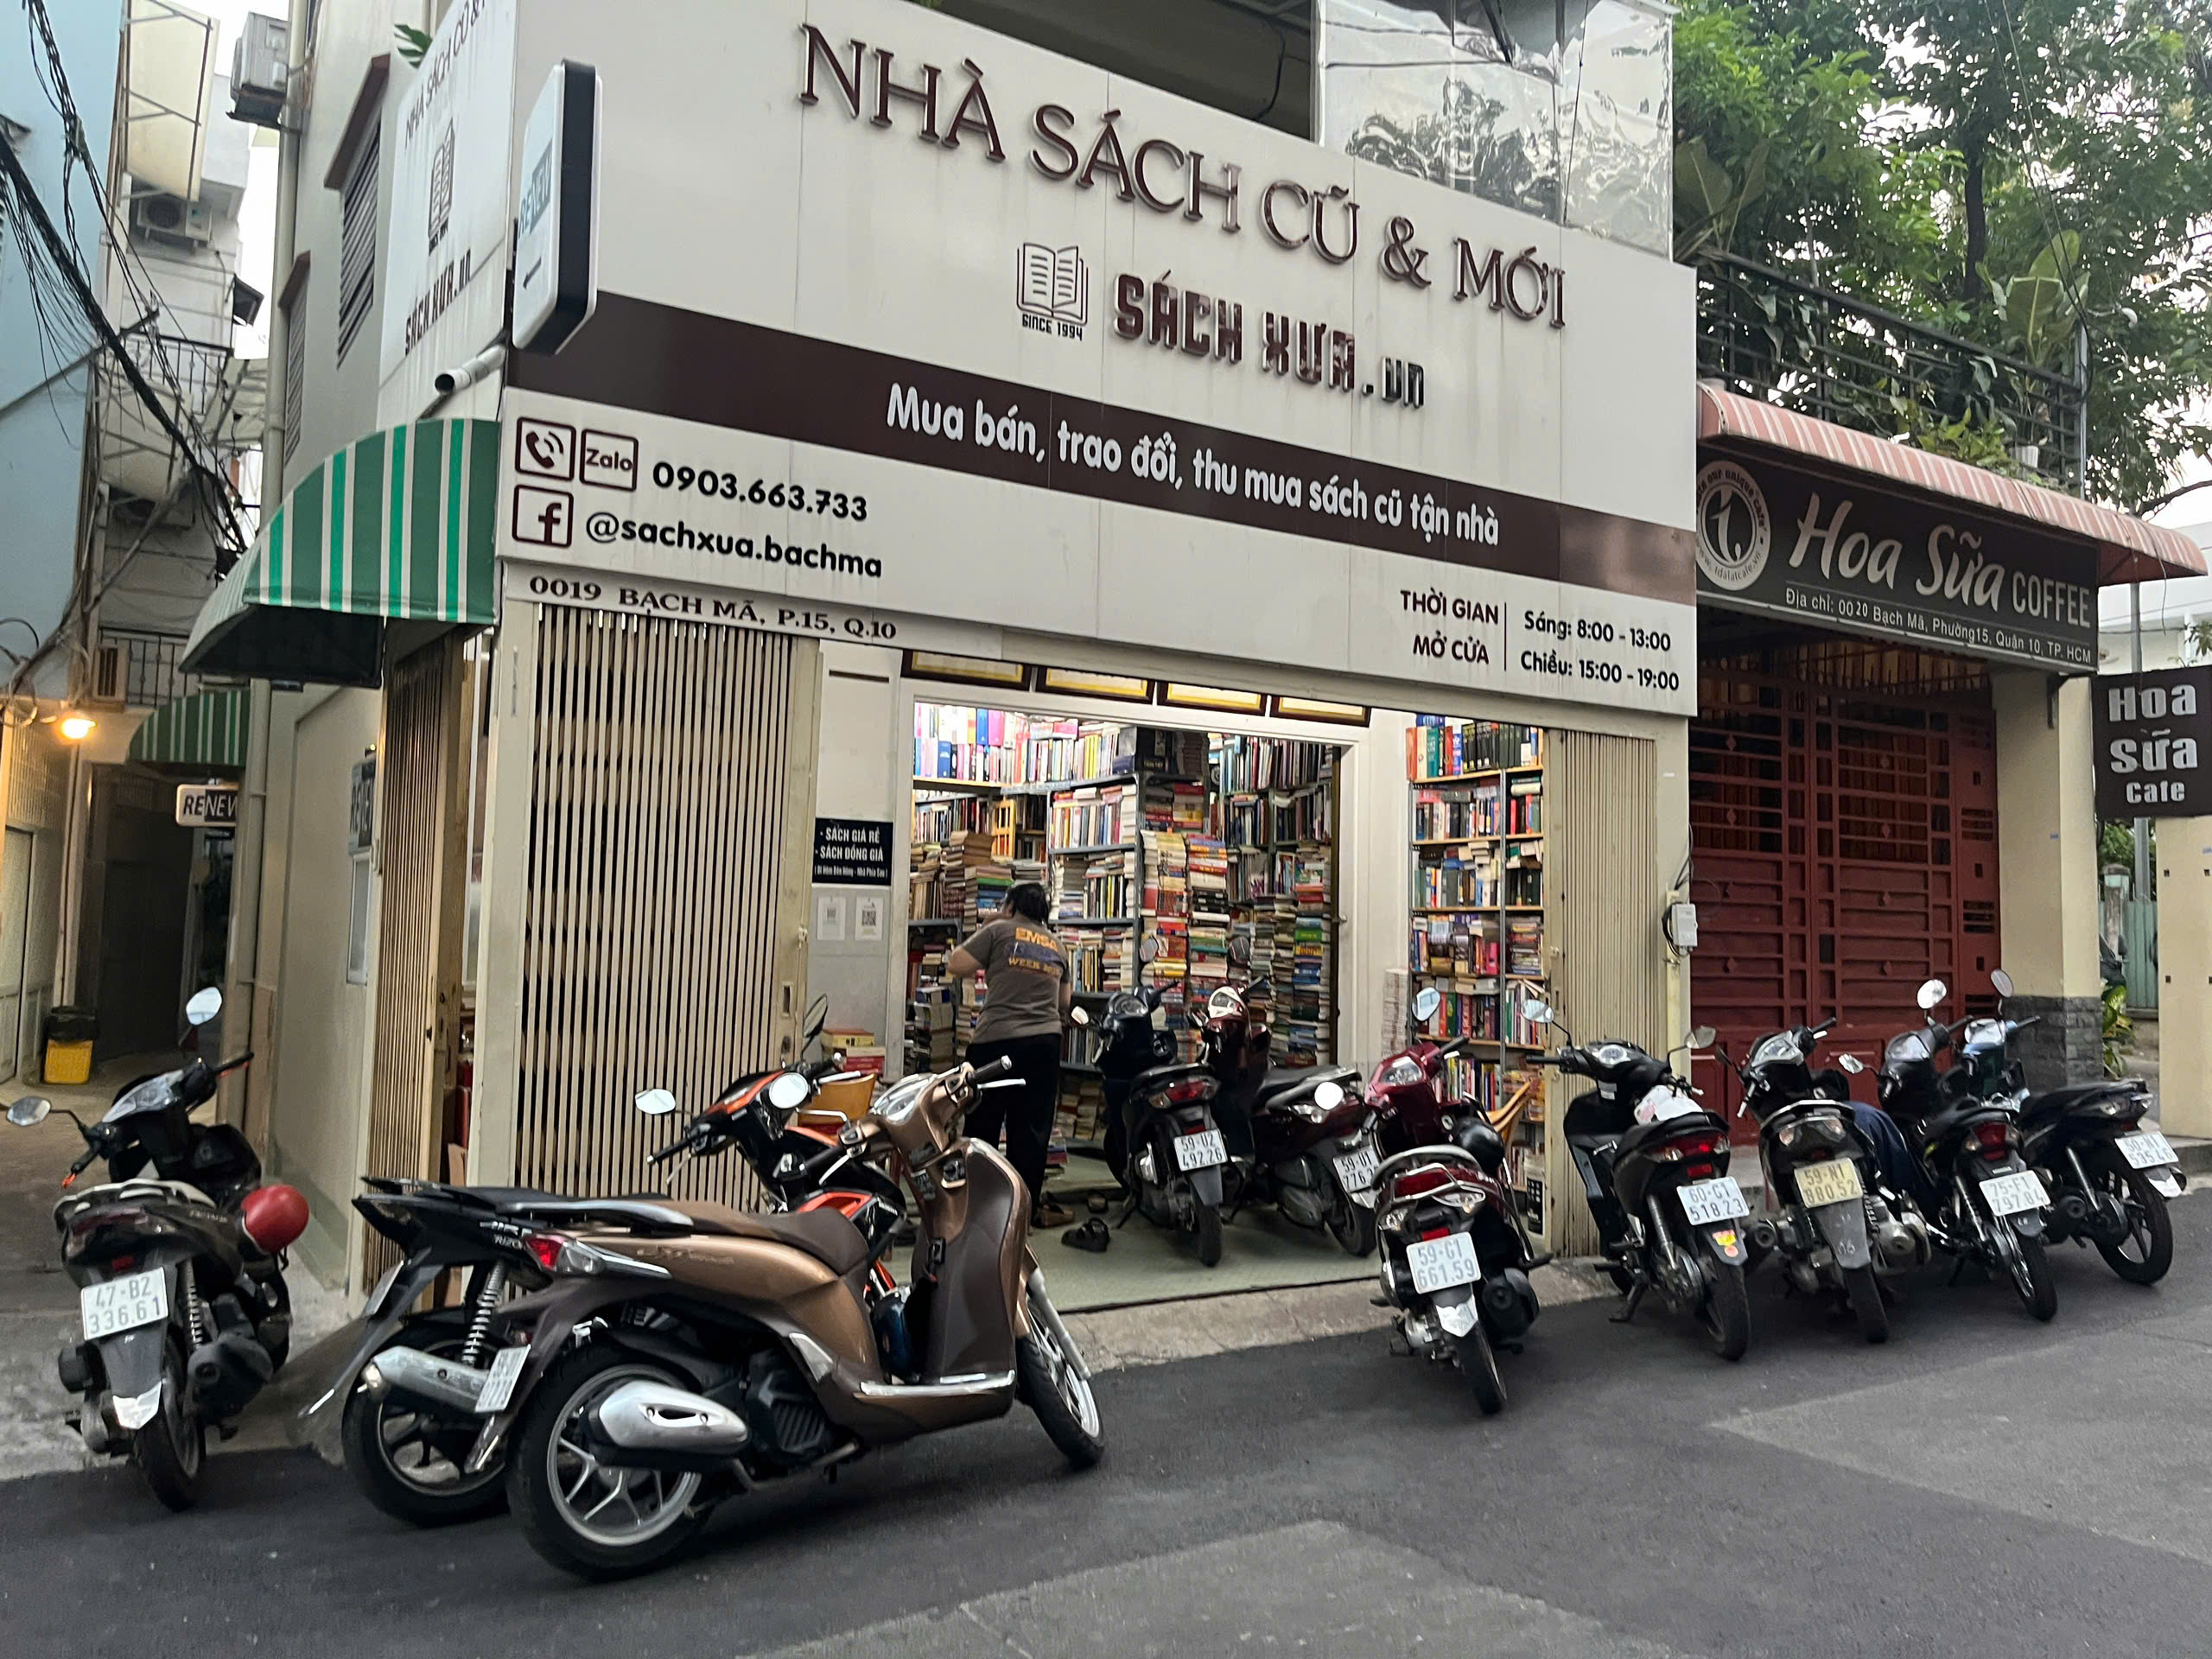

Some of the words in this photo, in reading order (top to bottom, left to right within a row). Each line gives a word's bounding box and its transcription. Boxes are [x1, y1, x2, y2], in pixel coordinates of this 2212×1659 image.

[798, 23, 1007, 162] NHÀ
[1029, 104, 1243, 233] SÁCH
[1260, 178, 1361, 264] CŨ
[1379, 215, 1432, 289] &
[1452, 237, 1566, 329] MỚI
[1022, 313, 1052, 334] SINCE
[1057, 321, 1084, 341] 1994
[1113, 270, 1243, 364] SÁCH
[585, 448, 633, 473] Zalo
[652, 461, 868, 522] 0903.663.733
[887, 382, 964, 442] Mua
[975, 398, 1045, 463] bán,
[1057, 419, 1122, 473] trao
[1130, 431, 1183, 491] đổi,
[1192, 448, 1237, 495] thu
[1244, 467, 1303, 508] mua
[1309, 474, 1368, 520] sách
[1374, 488, 1402, 527] cũ
[1410, 493, 1449, 543] tận
[1456, 503, 1499, 546] nhà
[585, 511, 882, 577] @sachxua.bachma
[1789, 491, 1903, 590] Hoa
[1915, 524, 2005, 613] Sữa
[2012, 570, 2091, 628] COFFEE
[529, 575, 602, 601] 0019
[619, 588, 703, 616] BẠCH
[712, 599, 766, 625] MÃ,
[778, 607, 836, 634] P.15,
[843, 617, 897, 640] Q.10
[1401, 588, 1447, 617] THỜI
[1452, 598, 1499, 625] GIAN
[1785, 588, 1807, 609] Địa
[1873, 606, 1903, 627] Bạch
[1907, 613, 1929, 632] Mã,
[1996, 630, 2024, 651] Quận
[2066, 646, 2092, 664] HCM
[1413, 630, 1447, 658] MỞ
[1452, 637, 1490, 664] CỬA
[1524, 610, 1572, 640] Sáng:
[1577, 619, 1614, 643] 8:00
[1630, 627, 1671, 652] 13:00
[1521, 650, 1573, 676] Chiều:
[1579, 659, 1622, 683] 15:00
[1637, 668, 1680, 691] 19:00
[2108, 683, 2197, 722] Hoa
[2109, 728, 2198, 773] Sữa
[2126, 780, 2185, 804] Cafe
[819, 843, 843, 860] SÁCH
[869, 846, 884, 862] GIÁ
[825, 823, 849, 842] SÁCH
[851, 826, 867, 843] GIÁ
